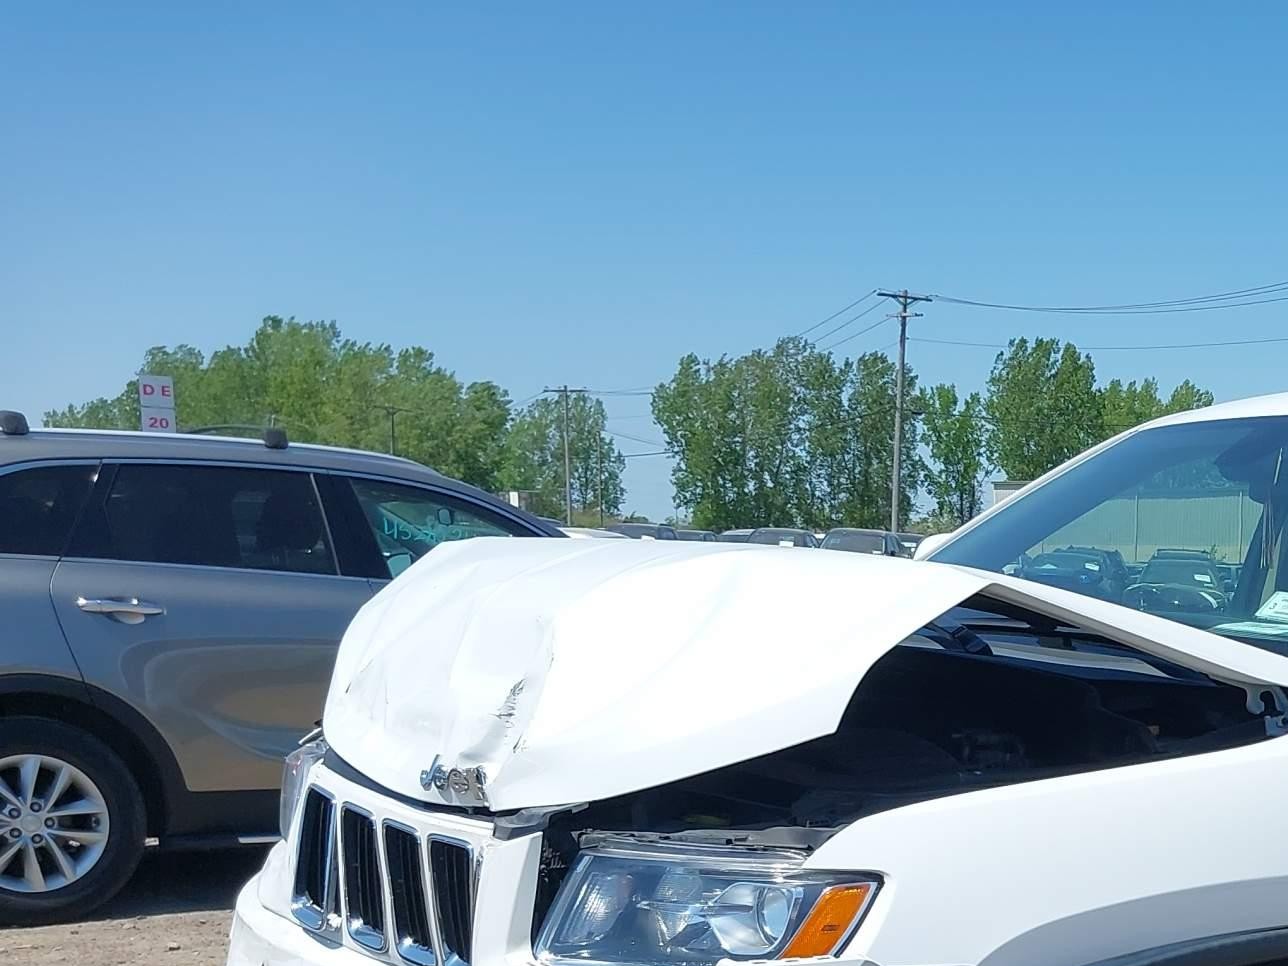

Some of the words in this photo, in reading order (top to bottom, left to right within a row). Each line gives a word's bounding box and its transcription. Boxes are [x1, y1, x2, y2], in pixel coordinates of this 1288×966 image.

[143, 384, 155, 396] D
[161, 385, 171, 397] E
[149, 417, 169, 429] 20
